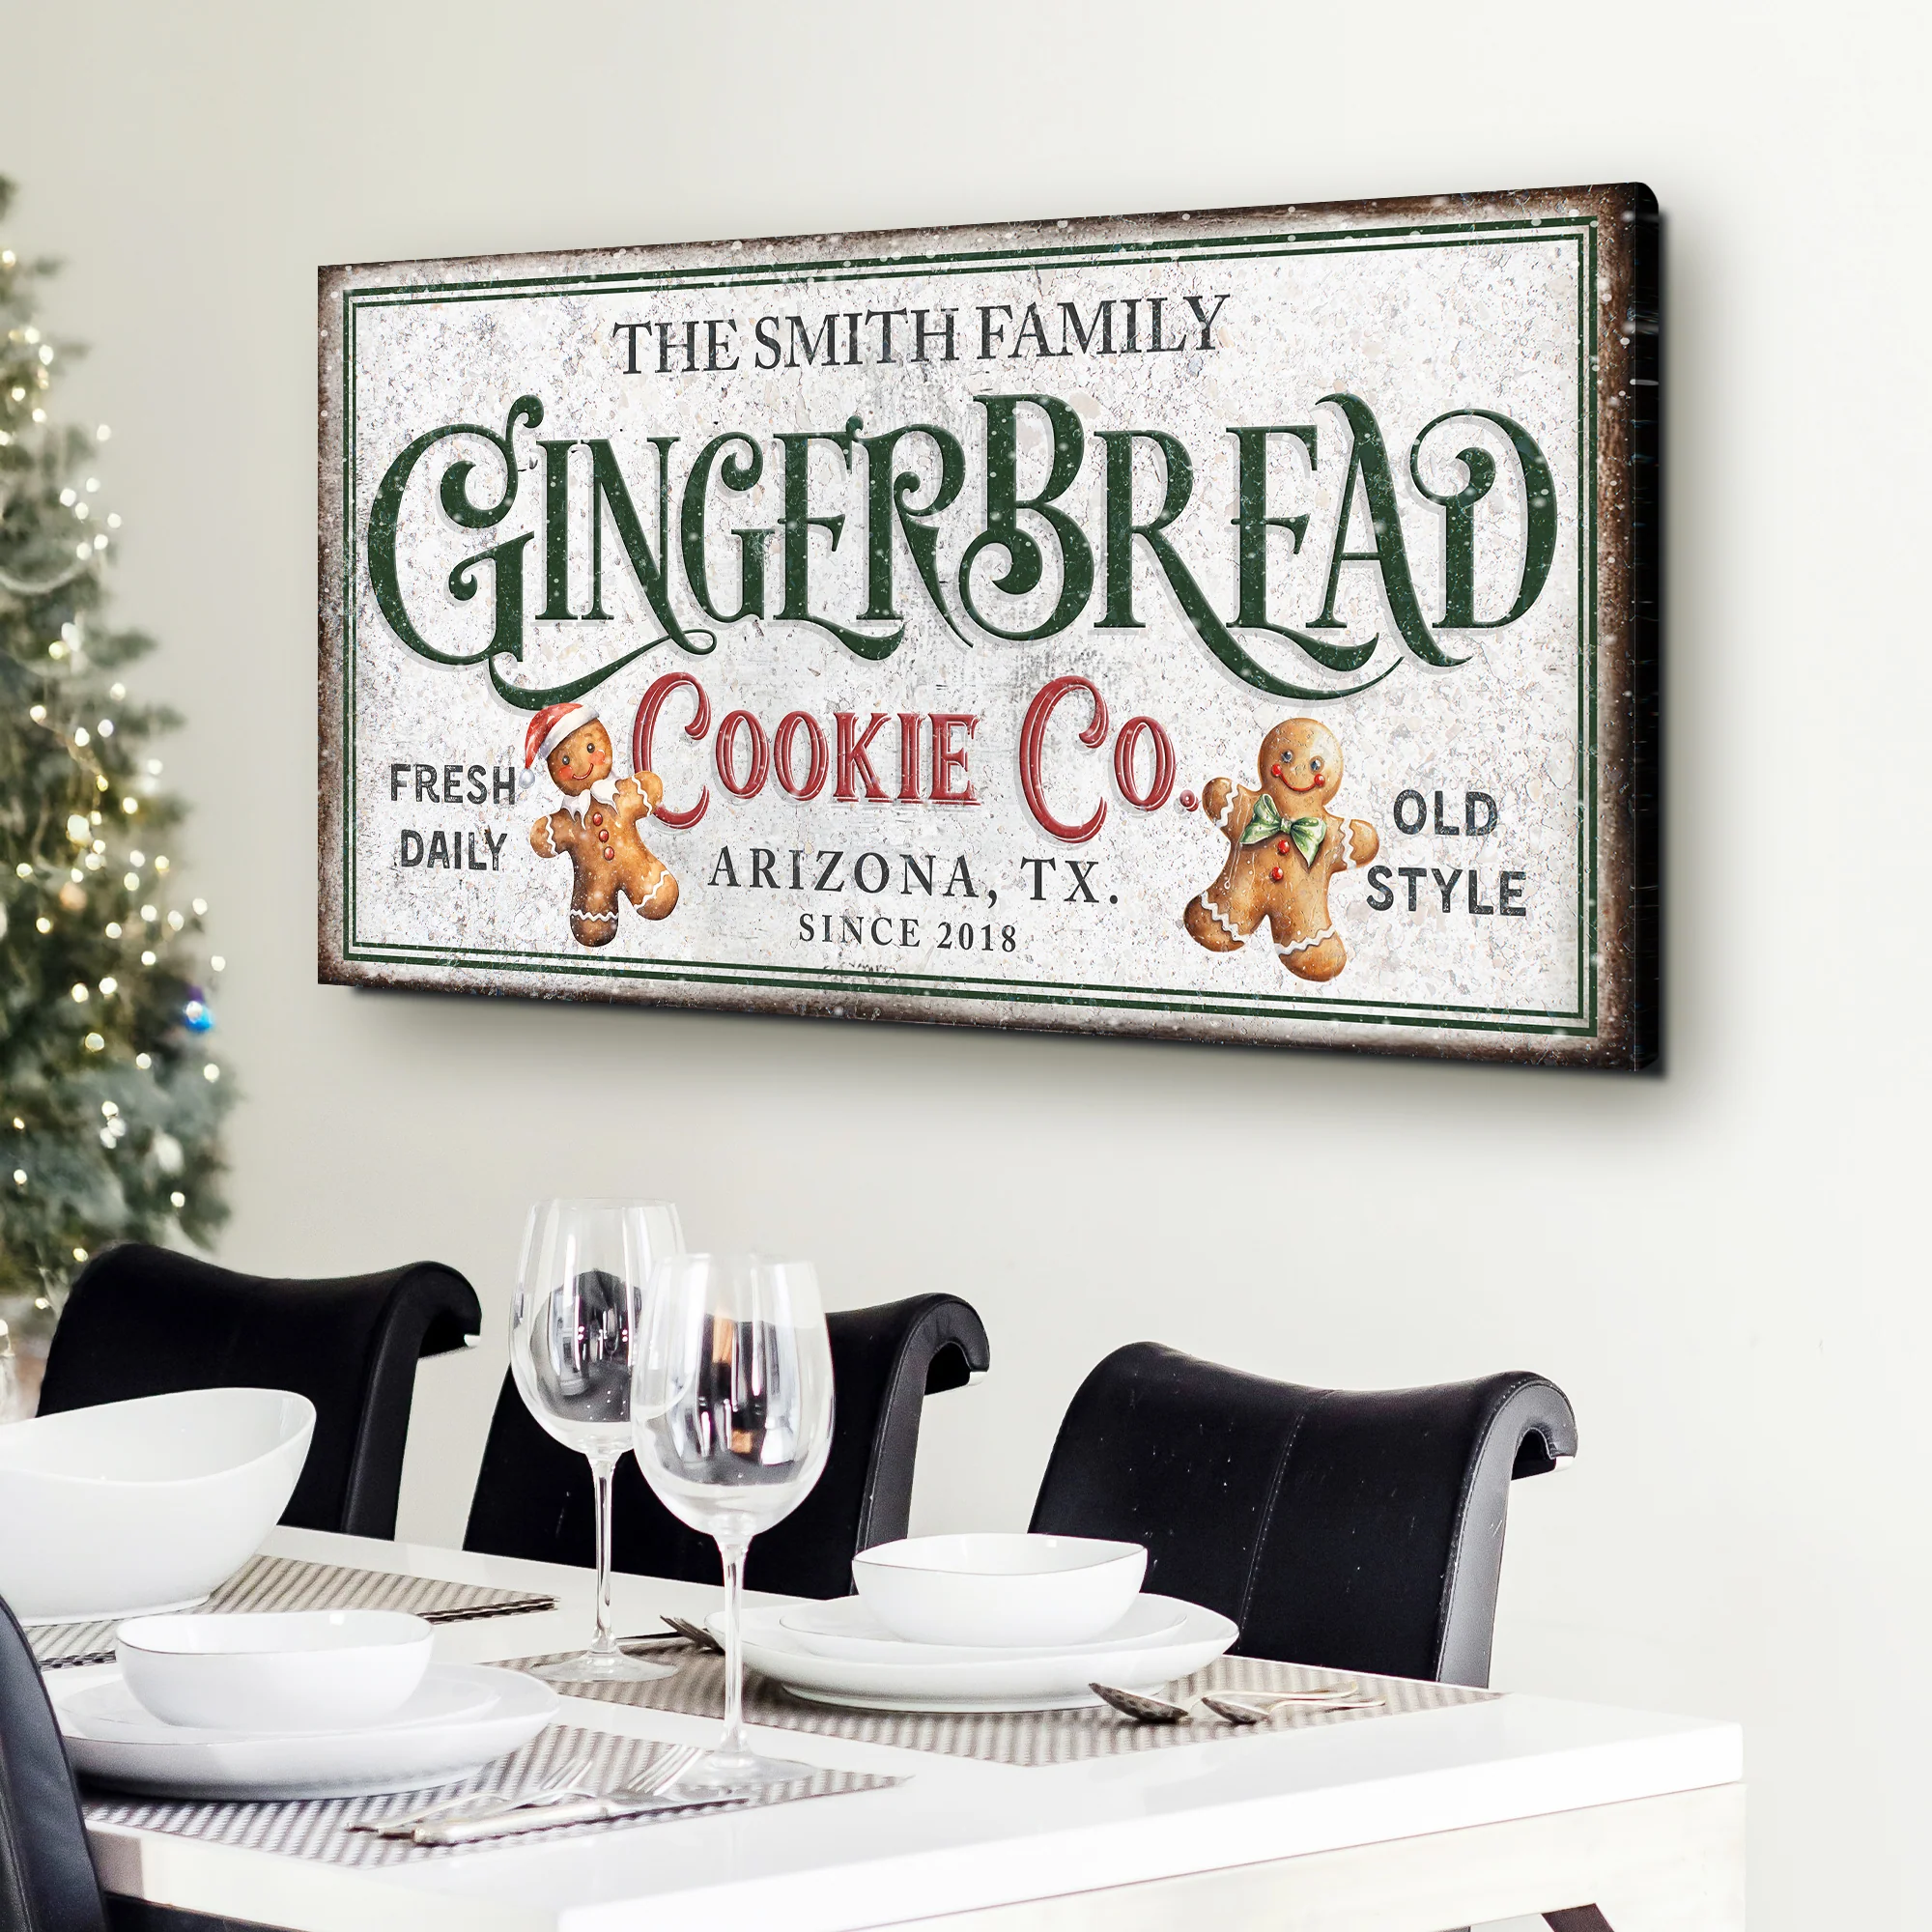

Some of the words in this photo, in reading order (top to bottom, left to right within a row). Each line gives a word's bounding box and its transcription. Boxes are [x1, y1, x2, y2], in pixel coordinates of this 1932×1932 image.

[612, 317, 740, 376] THE
[753, 307, 960, 370] SMITH
[976, 293, 1231, 360] FAMILY
[632, 671, 982, 831] COOKIE
[389, 762, 517, 807] FRESH
[1392, 788, 1500, 838] OLD
[400, 827, 508, 872] DAILY
[707, 844, 998, 909] ARIZONA,
[1020, 856, 1120, 906] TX.
[1365, 865, 1528, 918] STYLE
[798, 912, 921, 950] SINCE
[936, 922, 1017, 953] 2018
